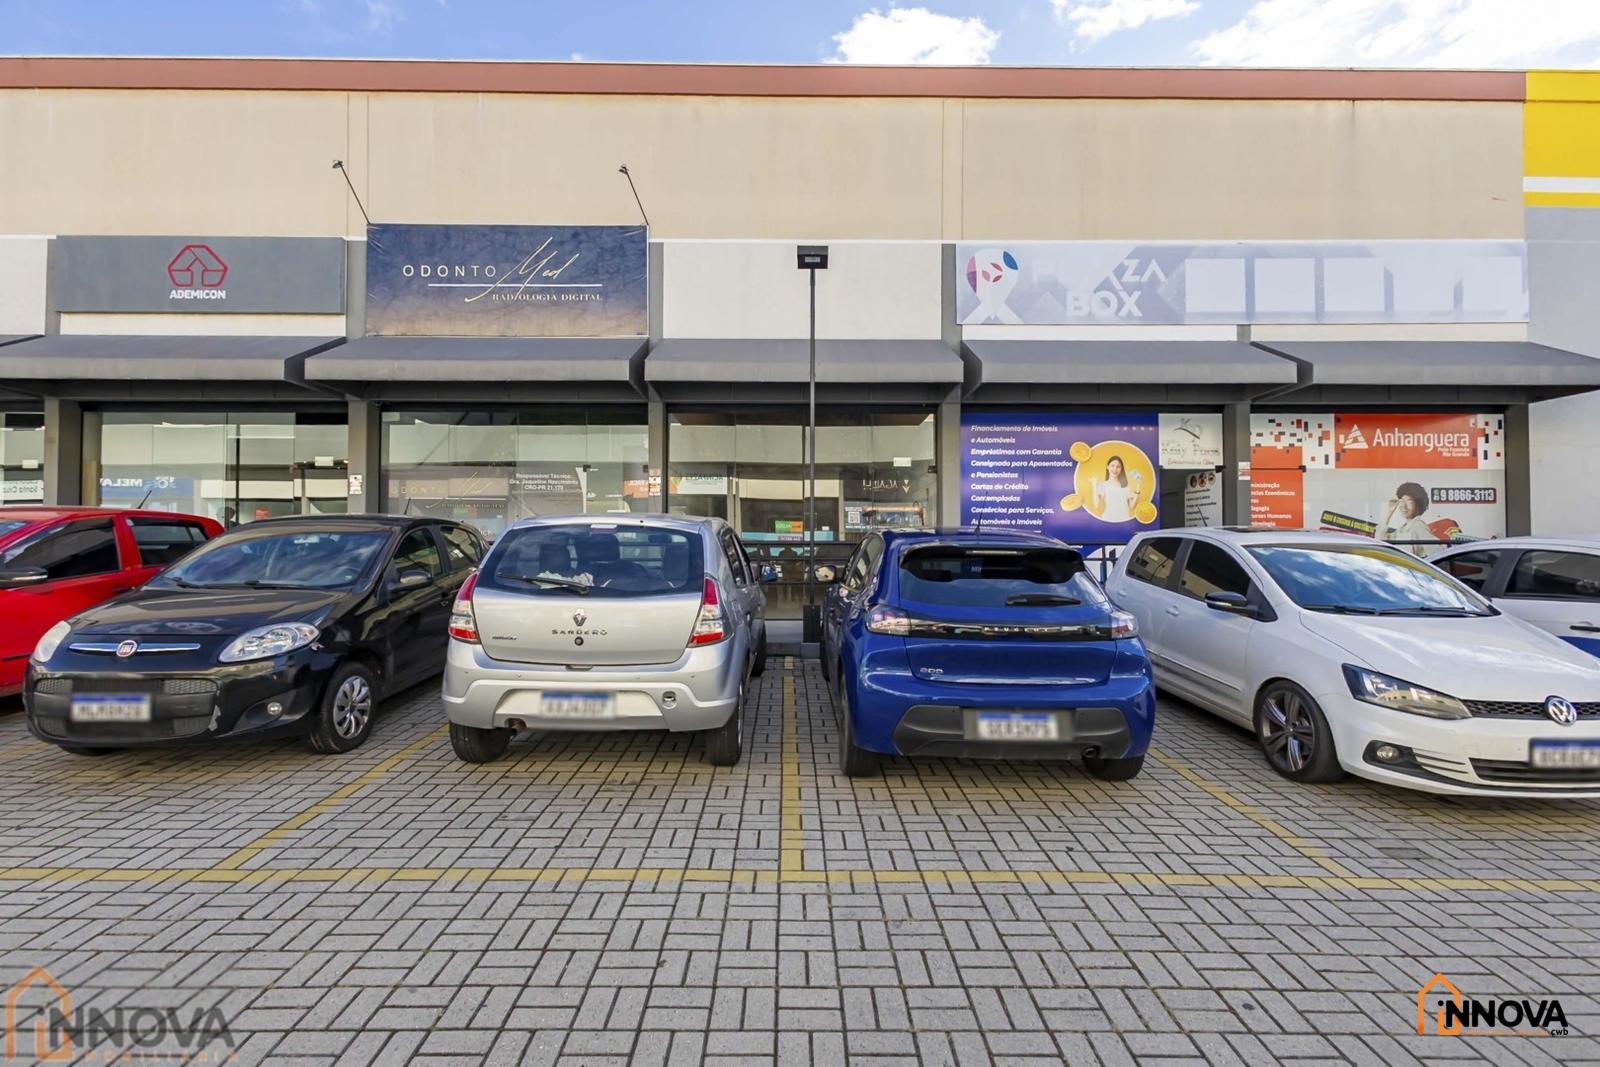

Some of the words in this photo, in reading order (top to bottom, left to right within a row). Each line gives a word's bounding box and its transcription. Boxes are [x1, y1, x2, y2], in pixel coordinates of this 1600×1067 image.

[402, 265, 496, 277] ODONTO
[169, 290, 226, 299] ADEMICON
[1066, 290, 1142, 317] BOX
[1372, 427, 1470, 453] Anhanguera
[970, 448, 1015, 456] Empréstimos
[970, 460, 1011, 468] Consignado
[1029, 460, 1073, 468] Aposentados
[1440, 490, 1446, 500] 9
[1448, 489, 1494, 501] 8866-3113
